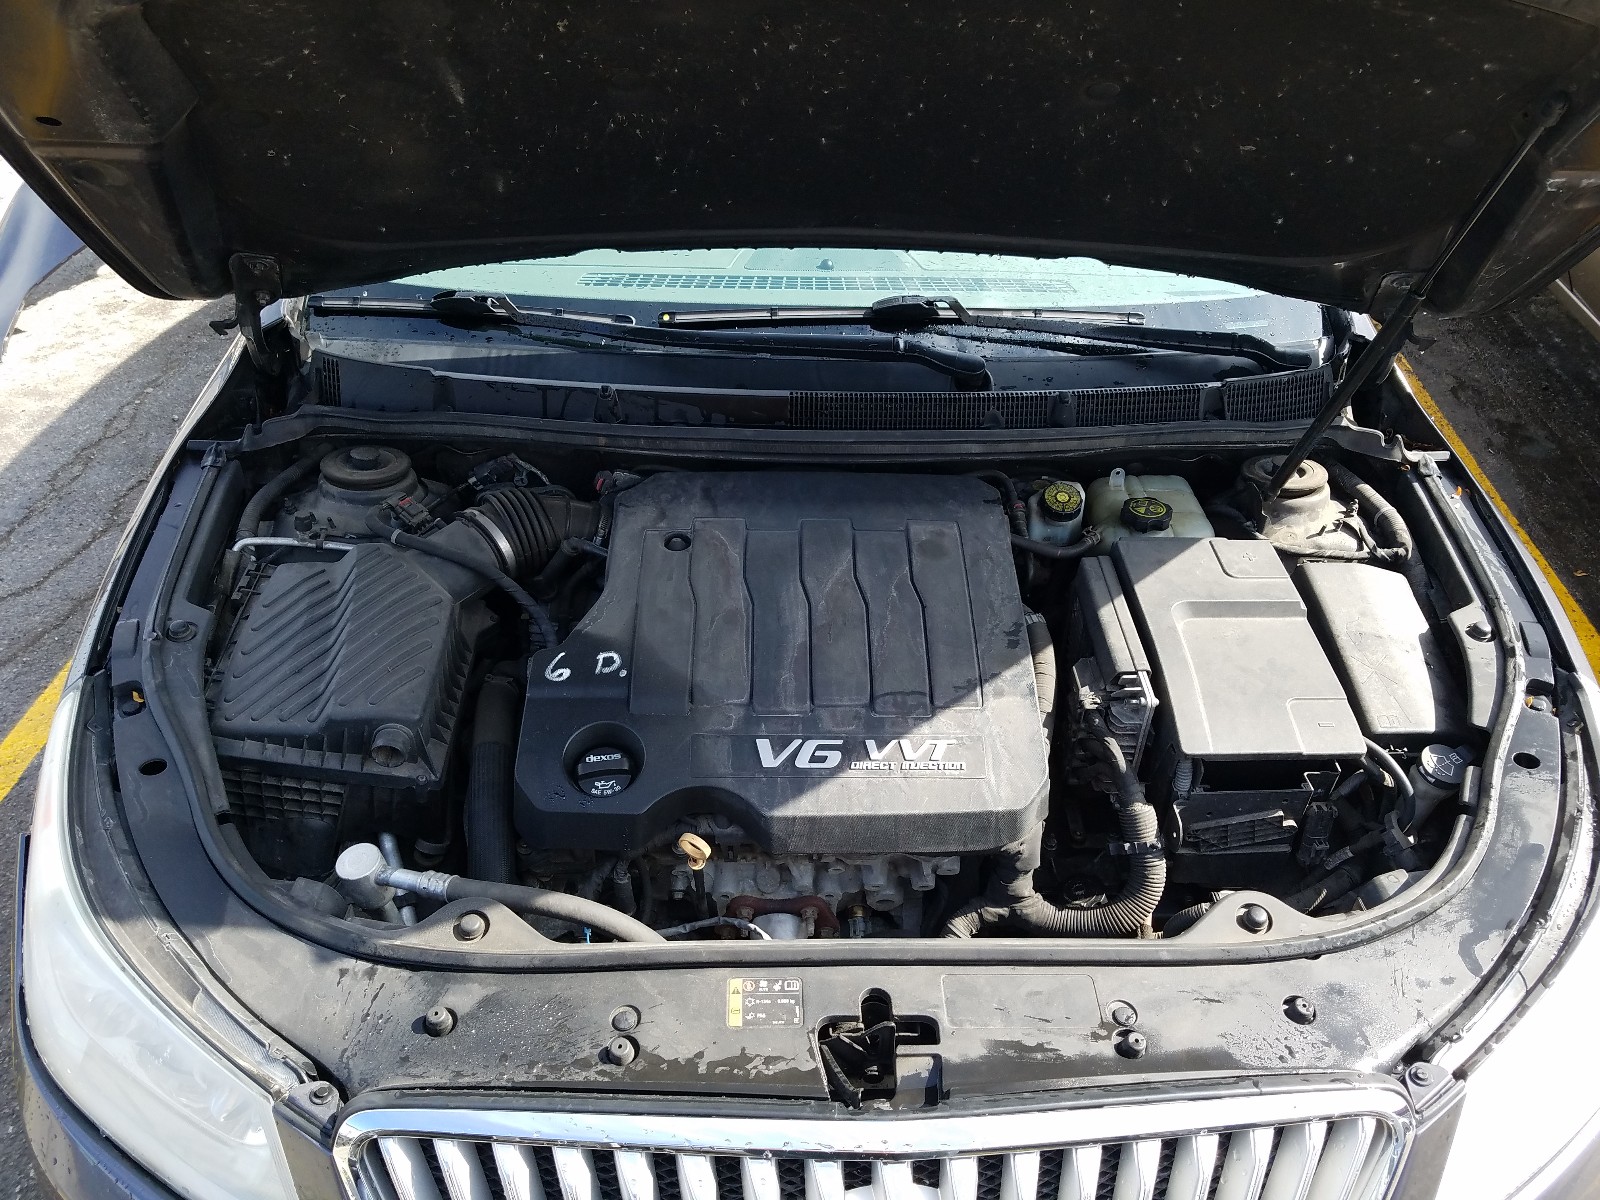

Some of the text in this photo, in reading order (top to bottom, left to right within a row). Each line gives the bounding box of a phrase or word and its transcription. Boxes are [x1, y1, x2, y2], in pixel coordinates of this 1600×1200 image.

[545, 651, 571, 681] 6
[585, 753, 622, 763] dexos
[755, 738, 957, 768] V6 VVT
[850, 761, 966, 771] DIRECT INJECTION
